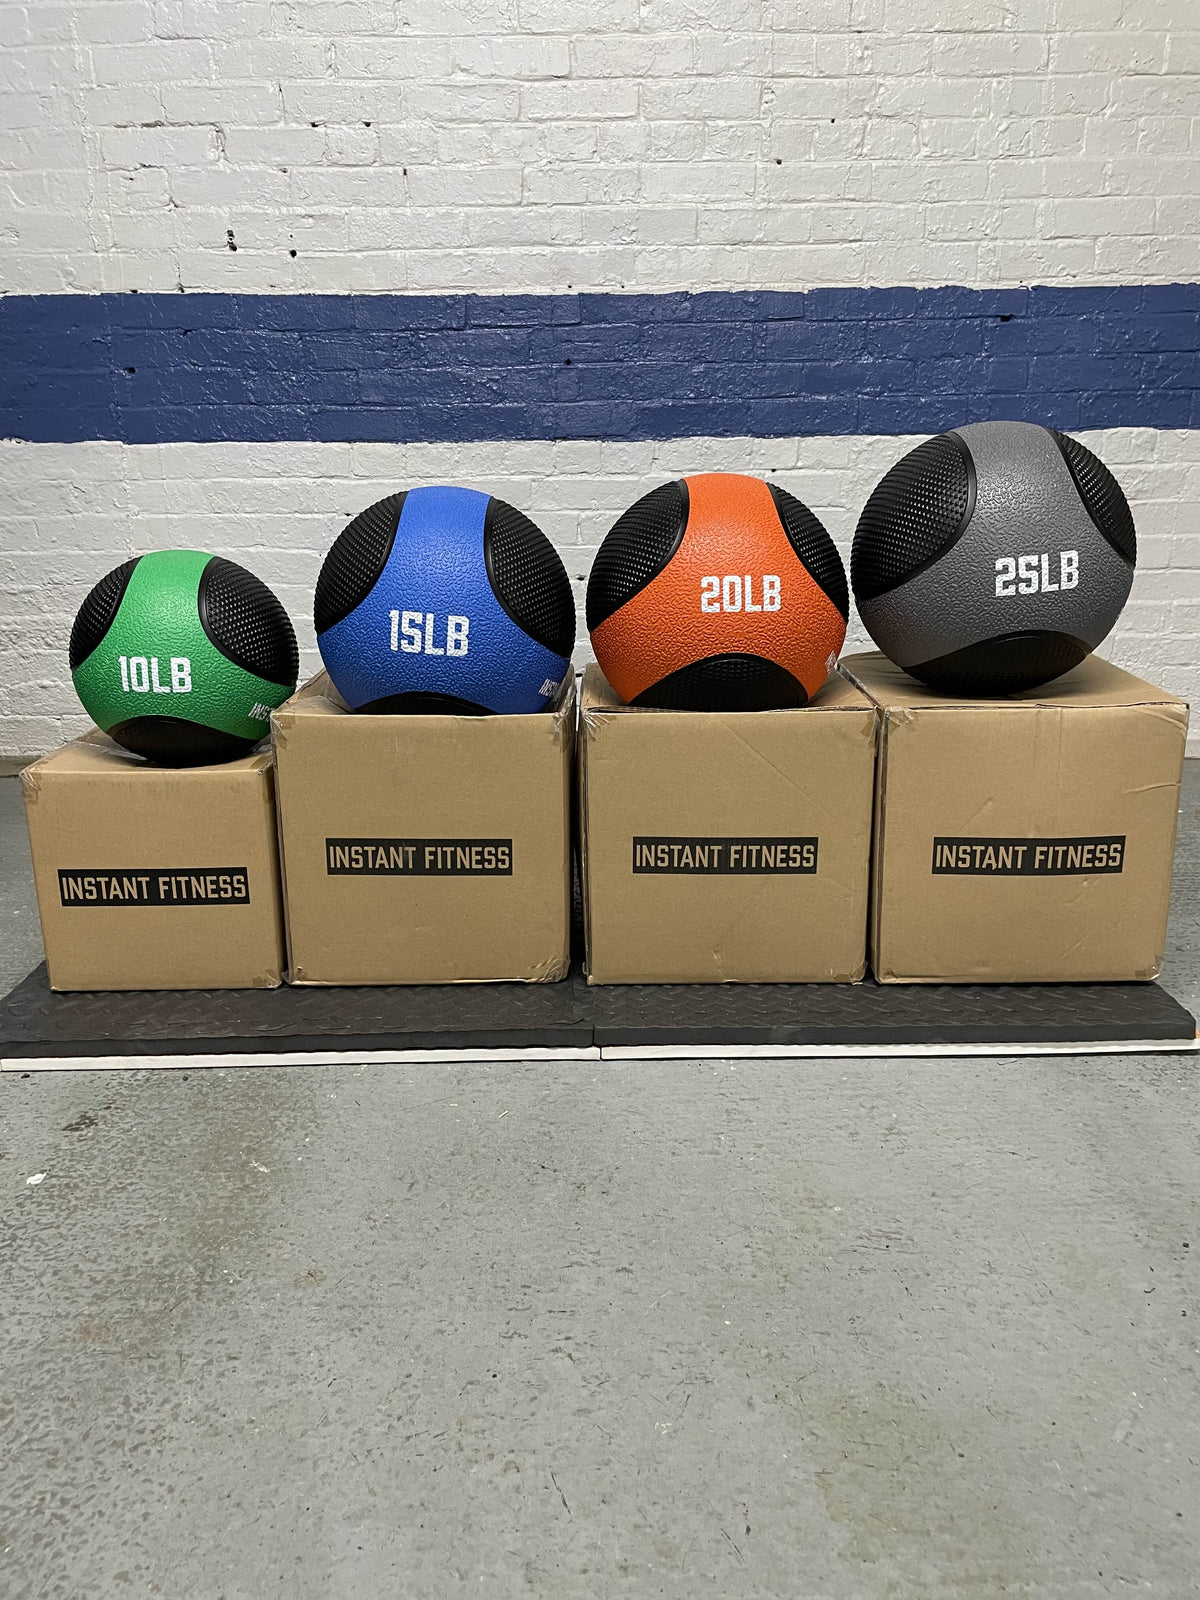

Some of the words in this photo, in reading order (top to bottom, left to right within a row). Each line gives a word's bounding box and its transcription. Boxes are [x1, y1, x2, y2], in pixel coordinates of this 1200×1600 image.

[994, 550, 1079, 597] 25LB
[700, 574, 782, 613] 20LB
[389, 609, 470, 657] 15LB
[118, 655, 192, 693] 10LB
[328, 846, 416, 870] INSTANT
[424, 846, 510, 870] FITNESS
[635, 844, 722, 869] INSTANT
[729, 845, 815, 868] FITNESS
[935, 844, 1027, 870] INSTANT
[1034, 843, 1122, 869] FITNESS
[62, 876, 150, 900] INSTANT
[158, 875, 247, 899] FITNESS
